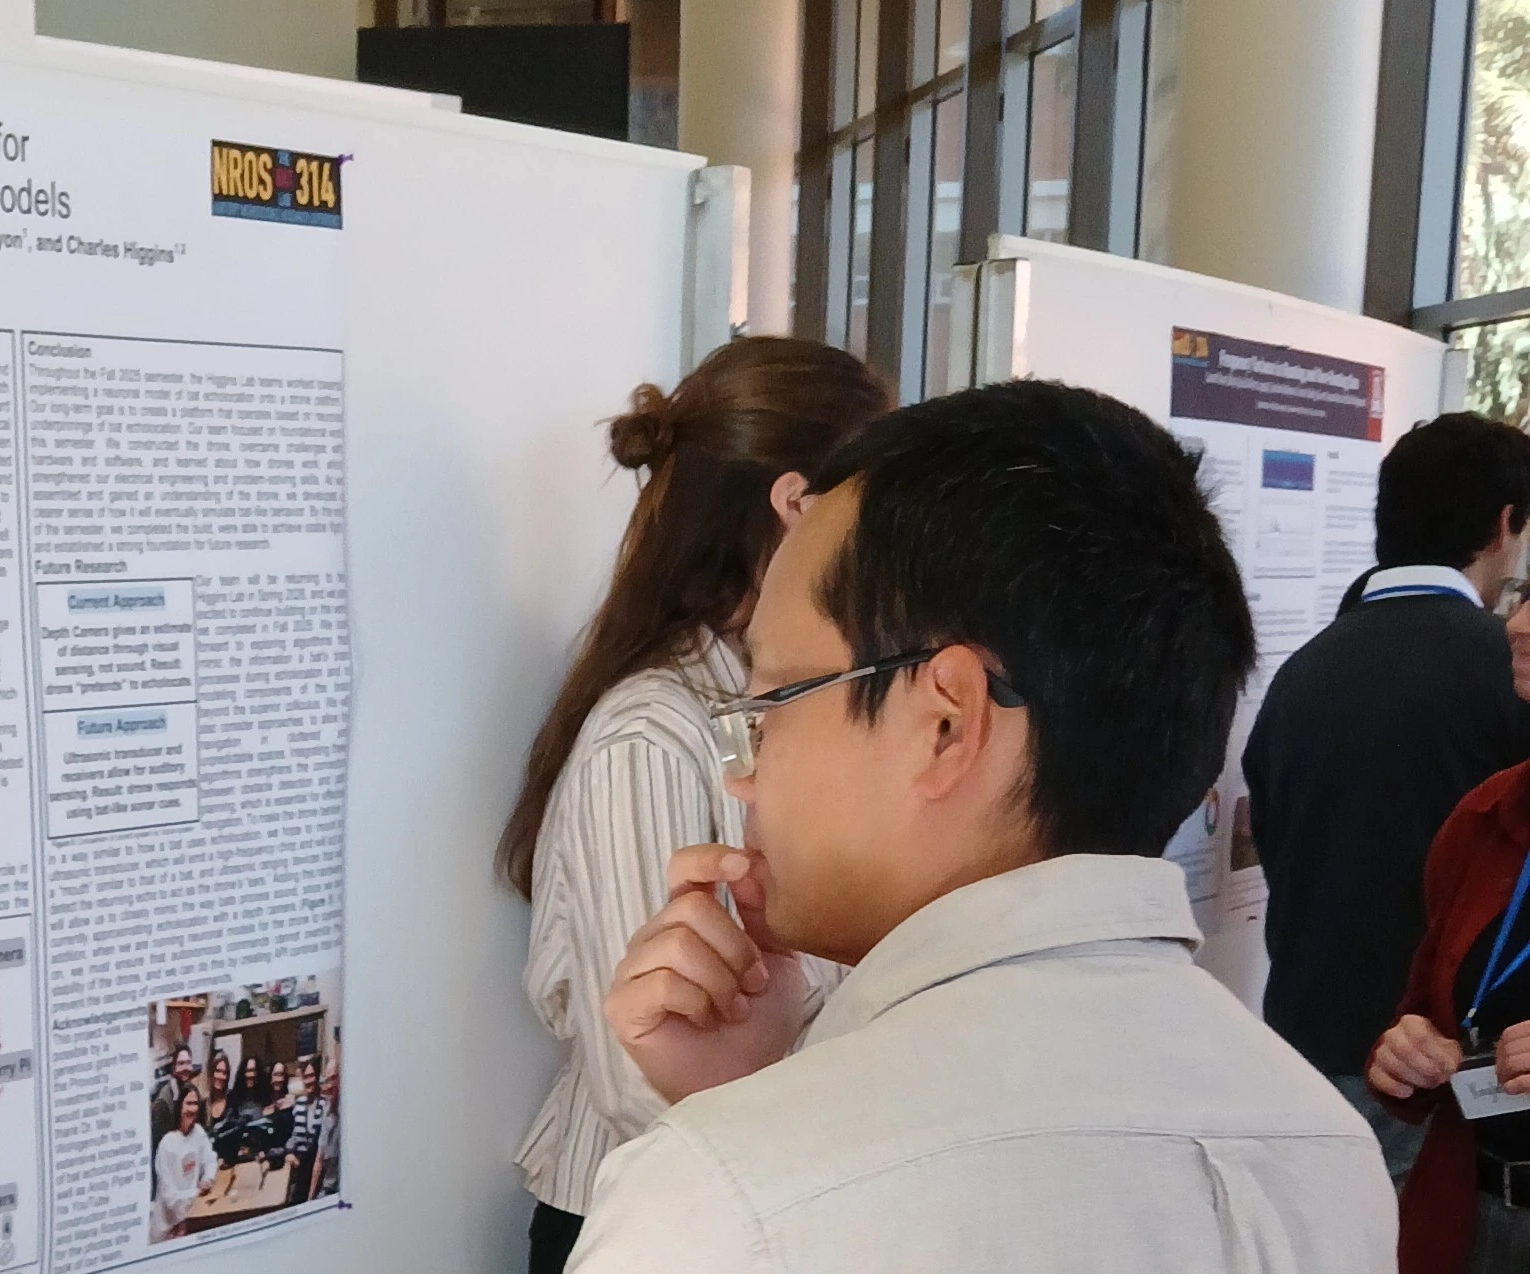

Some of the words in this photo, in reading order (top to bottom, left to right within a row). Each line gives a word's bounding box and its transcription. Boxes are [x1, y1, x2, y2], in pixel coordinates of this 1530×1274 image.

[213, 146, 274, 201] NROS
[295, 158, 336, 208] 314
[36, 236, 62, 253] and
[66, 235, 120, 259] Charles
[19, 1056, 32, 1072] Pi
